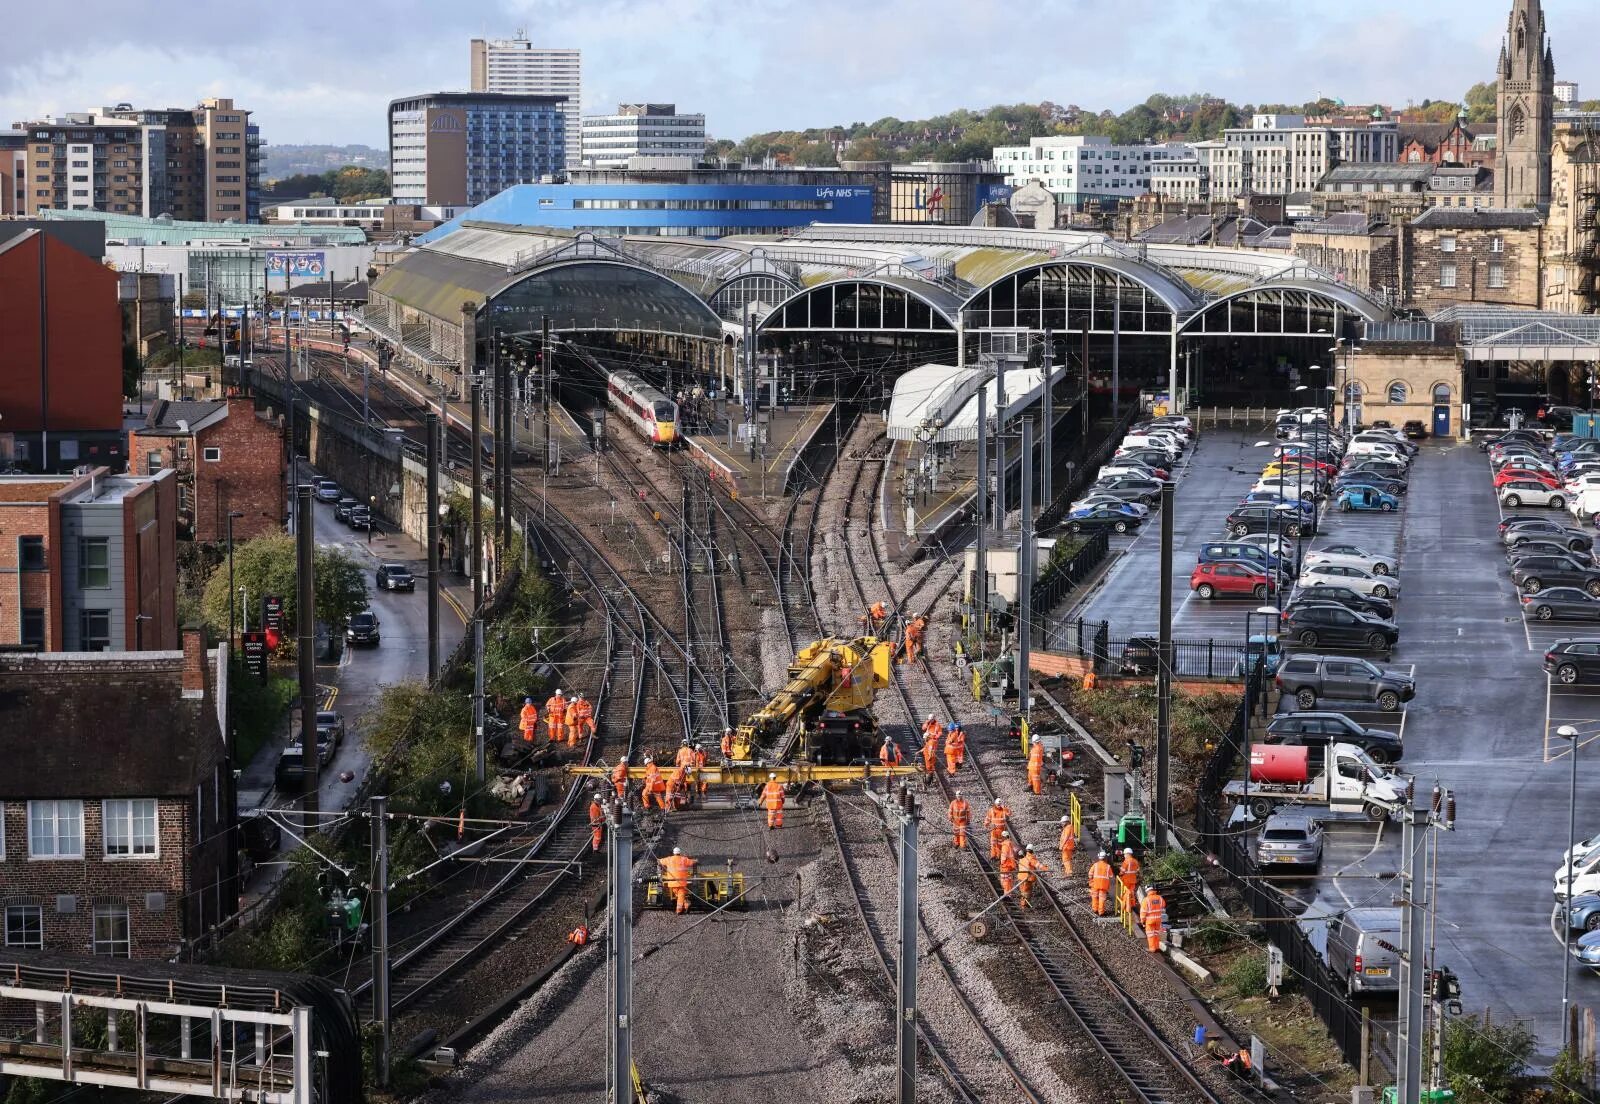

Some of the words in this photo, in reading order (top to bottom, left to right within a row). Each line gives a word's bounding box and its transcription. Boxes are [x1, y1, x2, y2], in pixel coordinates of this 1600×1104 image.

[816, 188, 833, 198] Life
[836, 189, 852, 197] NHS
[974, 925, 982, 933] 15
